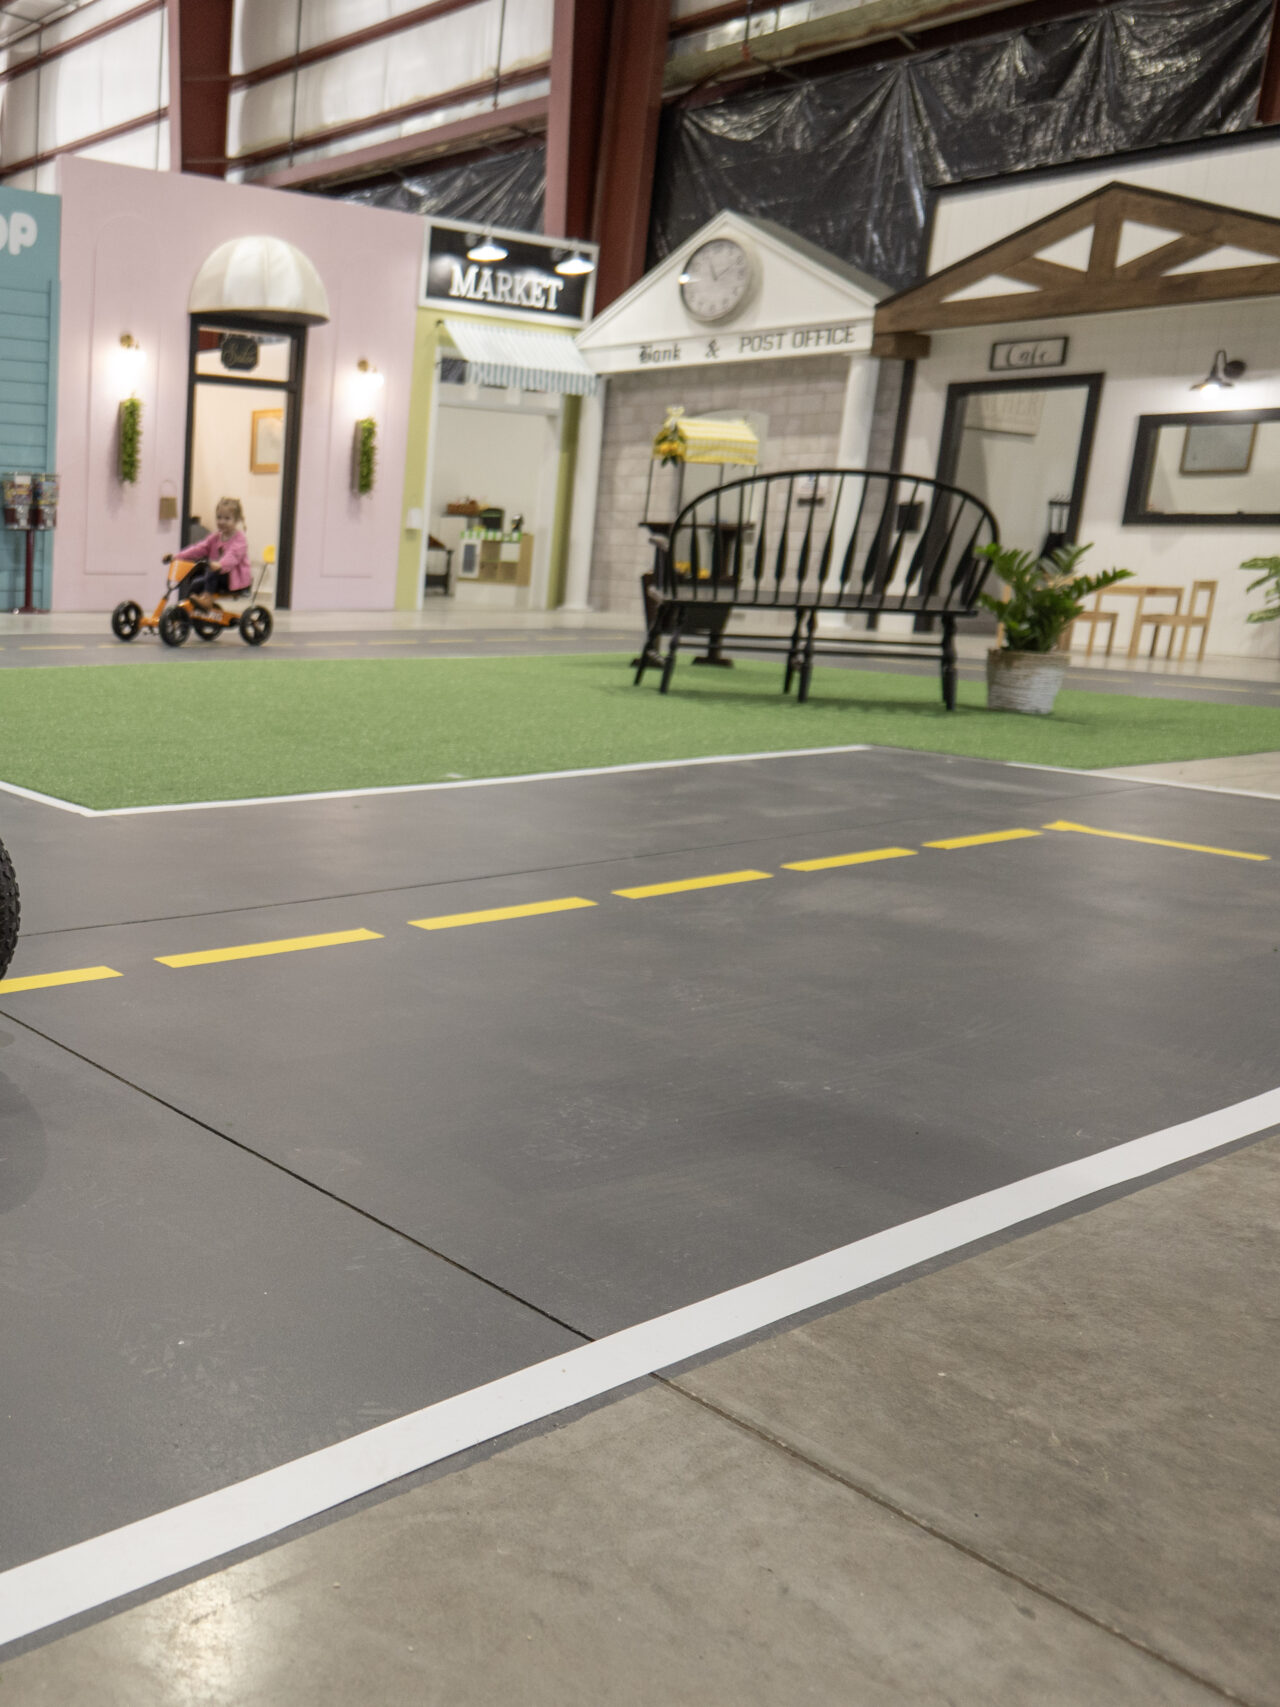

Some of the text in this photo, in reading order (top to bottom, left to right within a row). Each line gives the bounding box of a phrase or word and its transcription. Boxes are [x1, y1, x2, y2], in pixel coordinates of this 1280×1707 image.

[448, 263, 564, 311] MARKET
[638, 325, 858, 364] Bank & POST OFFICE
